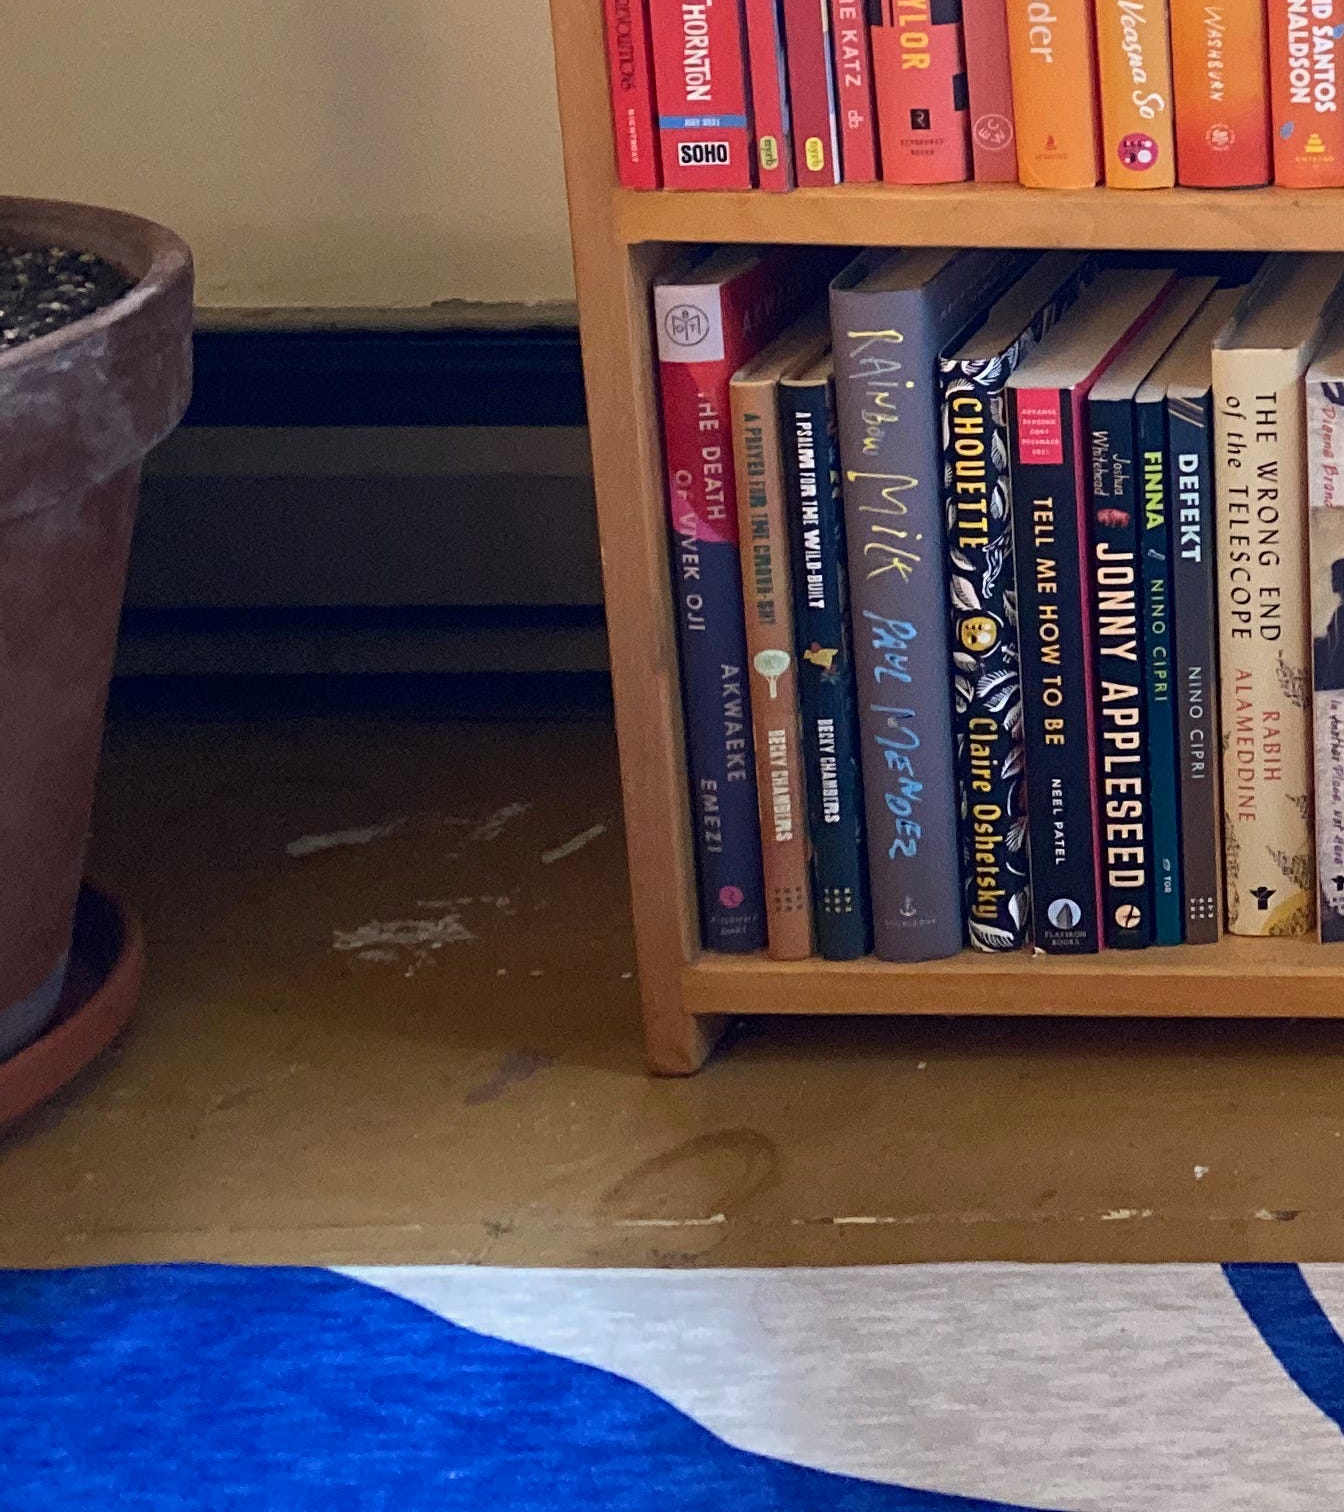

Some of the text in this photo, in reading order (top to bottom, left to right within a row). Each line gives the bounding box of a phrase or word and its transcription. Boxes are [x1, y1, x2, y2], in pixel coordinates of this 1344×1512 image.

[841, 26, 862, 87] KATZ
[1314, 25, 1337, 113] SANTOS
[681, 145, 728, 163] SOHO
[946, 396, 989, 551] CHOUETTE
[1143, 451, 1164, 530] FINNA
[1177, 452, 1201, 563] DEFEKT
[1257, 394, 1282, 641] THE WRONG END
[1034, 498, 1064, 744] TELL ME HOW TO BE
[1228, 484, 1252, 639] TELESCOPE
[1095, 542, 1145, 888] JONNY APPLESEED
[1234, 667, 1256, 823] ALAMEDDINE
[1263, 712, 1281, 781] RABIH
[967, 716, 1003, 923] Claire Oshetsky
